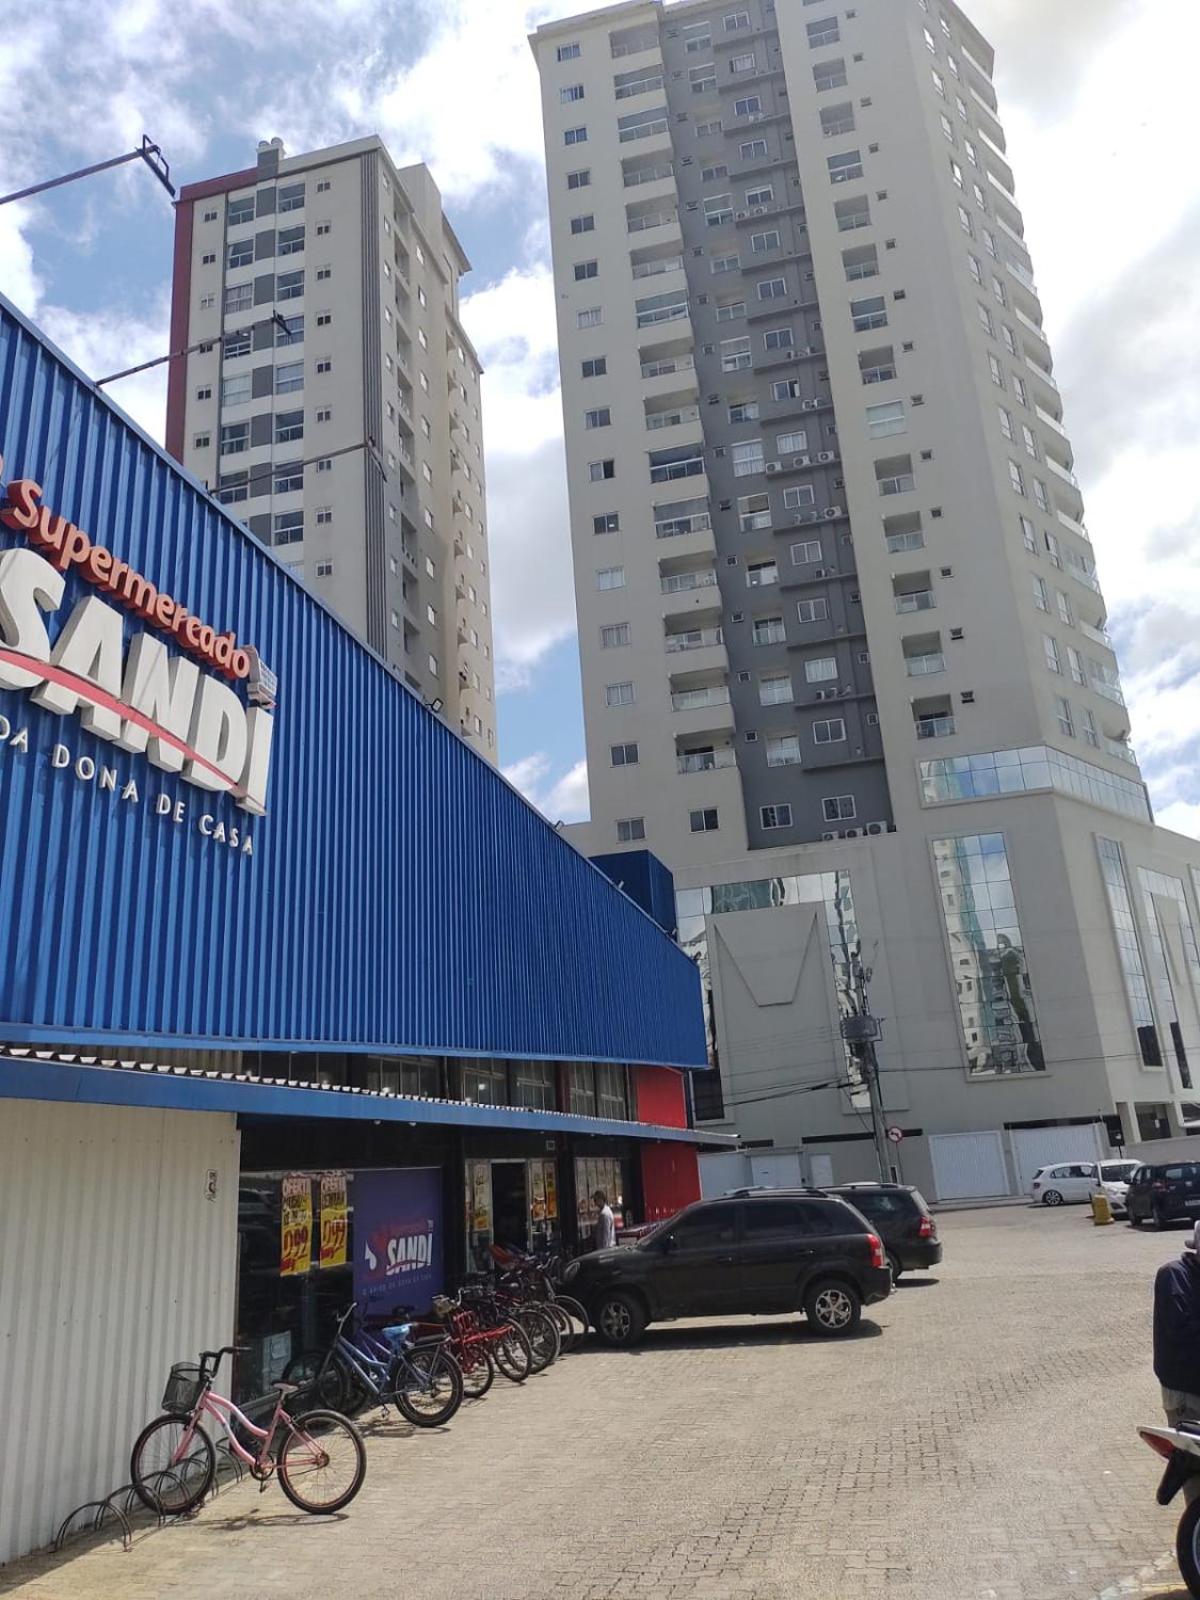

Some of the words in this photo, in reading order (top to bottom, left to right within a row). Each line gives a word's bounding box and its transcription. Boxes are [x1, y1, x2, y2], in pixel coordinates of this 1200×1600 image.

[5, 479, 251, 680] Supermercado
[53, 744, 140, 803] DONA
[156, 793, 186, 824] DE
[199, 814, 254, 856] CASA
[386, 1232, 433, 1276] SANDI
